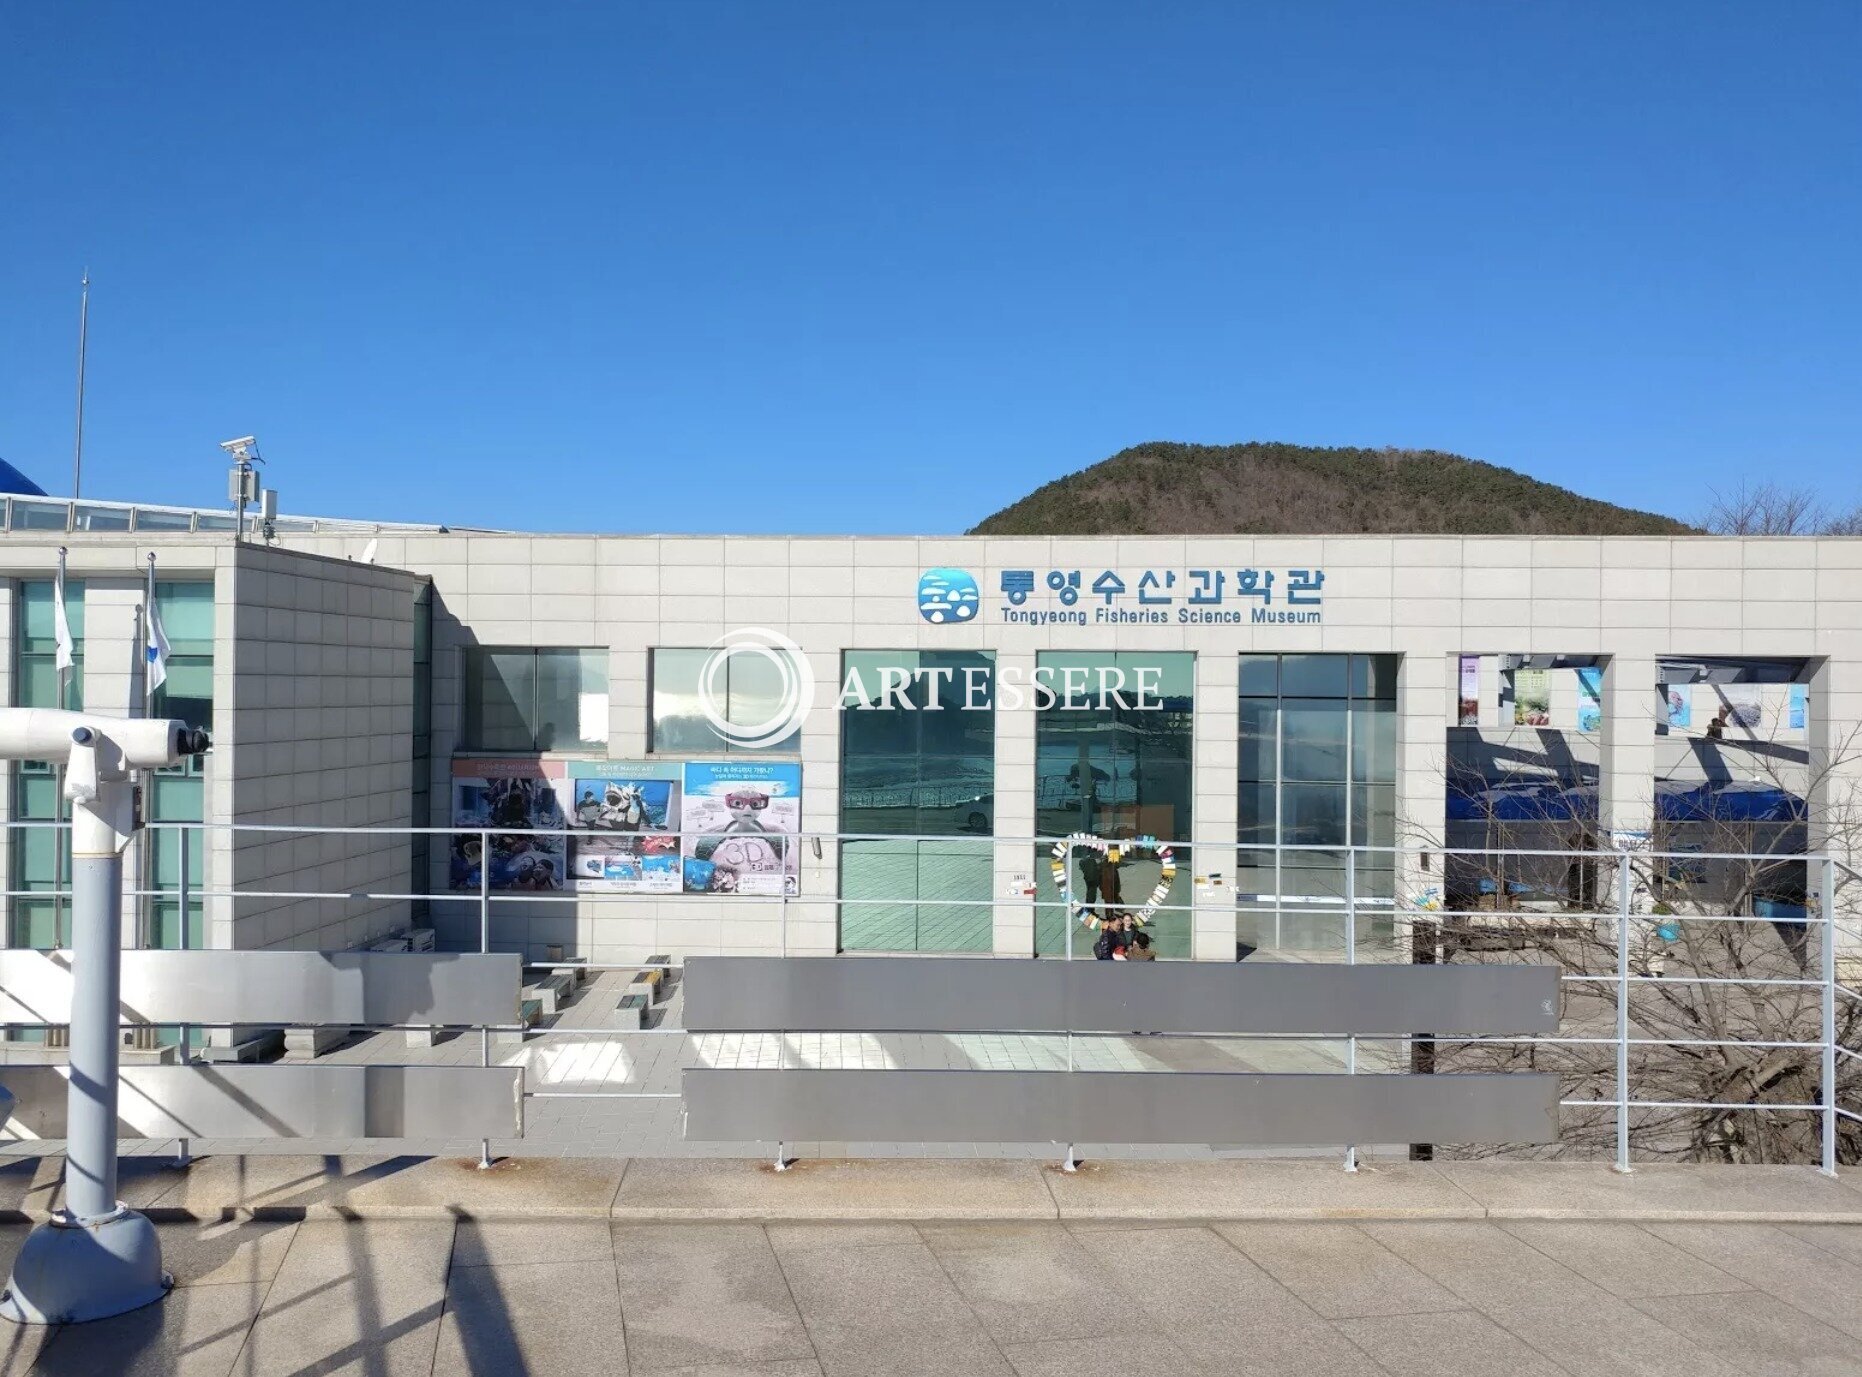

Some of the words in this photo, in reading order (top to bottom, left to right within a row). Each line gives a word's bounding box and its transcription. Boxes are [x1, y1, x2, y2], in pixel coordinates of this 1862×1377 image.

[1001, 568, 1325, 606] 통영수산과학관
[1001, 606, 1087, 626] Tongyeong
[1096, 606, 1169, 624] Fisheries
[1178, 607, 1241, 624] Science
[1251, 607, 1321, 624] Museum
[725, 841, 764, 866] 3D
